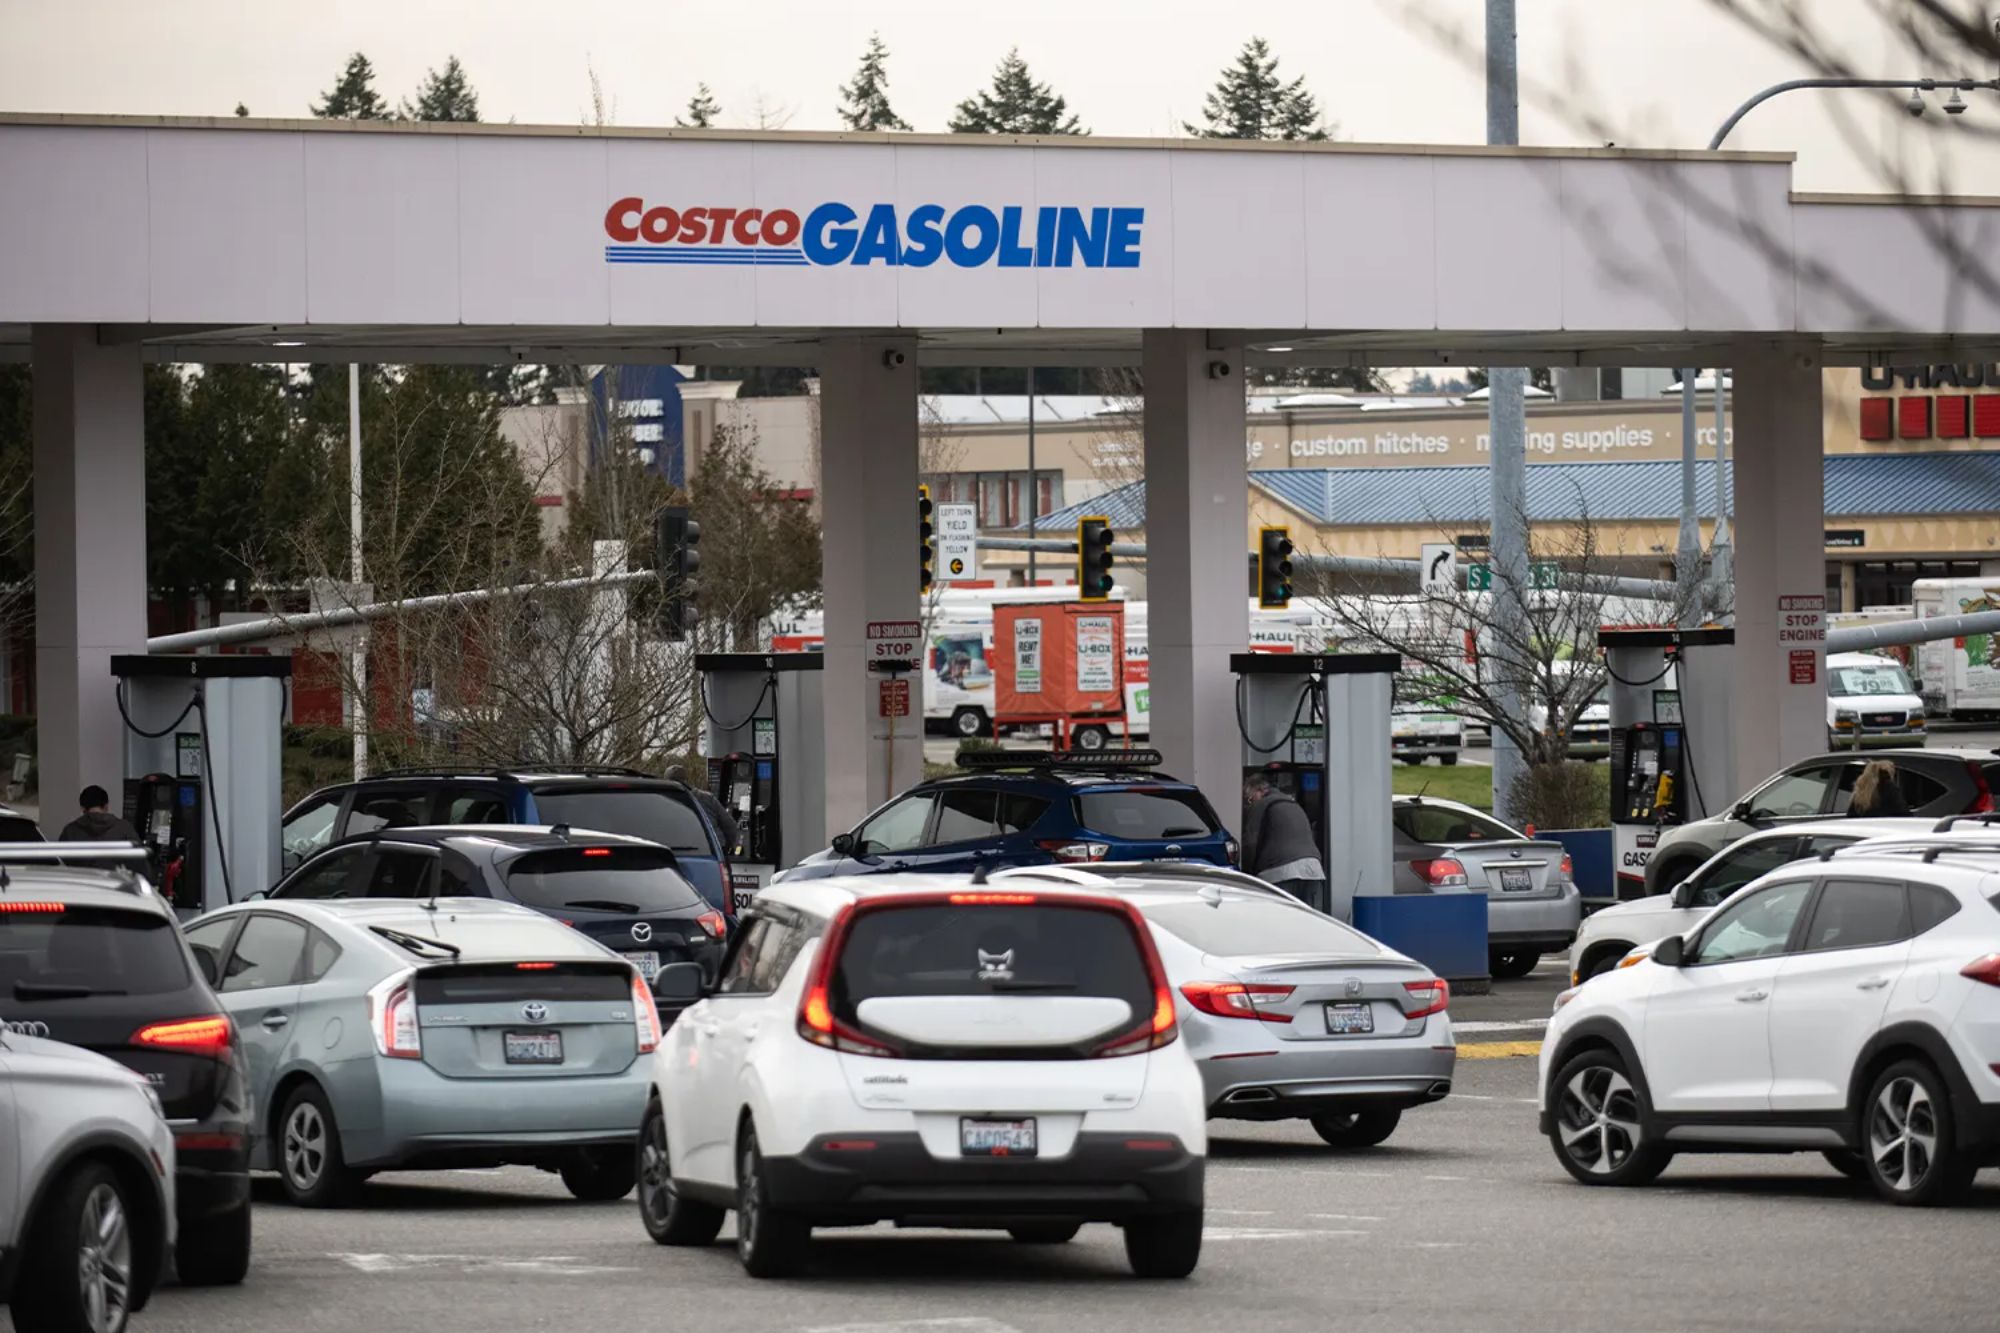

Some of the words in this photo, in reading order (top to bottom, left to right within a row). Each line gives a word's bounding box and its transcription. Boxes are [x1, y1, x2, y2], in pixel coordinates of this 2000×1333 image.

[604, 197, 800, 246] COSTCO
[801, 201, 1145, 268] GASOLINE
[1290, 434, 1368, 457] custom
[1374, 431, 1449, 455] hitches
[1476, 426, 1556, 453] ming
[1561, 424, 1654, 452] supplies
[940, 508, 955, 517] LEFT
[957, 508, 972, 516] TURN
[946, 520, 968, 530] YIELD
[945, 545, 969, 554] YELLOW
[1470, 567, 1482, 588] S
[1425, 584, 1449, 594] ONLY
[1785, 614, 1819, 626] STOP
[869, 625, 881, 638] NO
[882, 624, 918, 638] SMOKING
[1780, 629, 1825, 641] ENGINE
[875, 643, 913, 656] STOP
[1018, 641, 1038, 652] RENT
[1078, 644, 1111, 654] U-BOX
[191, 661, 197, 674] 8
[765, 656, 774, 669] 10
[1313, 659, 1324, 671] 12
